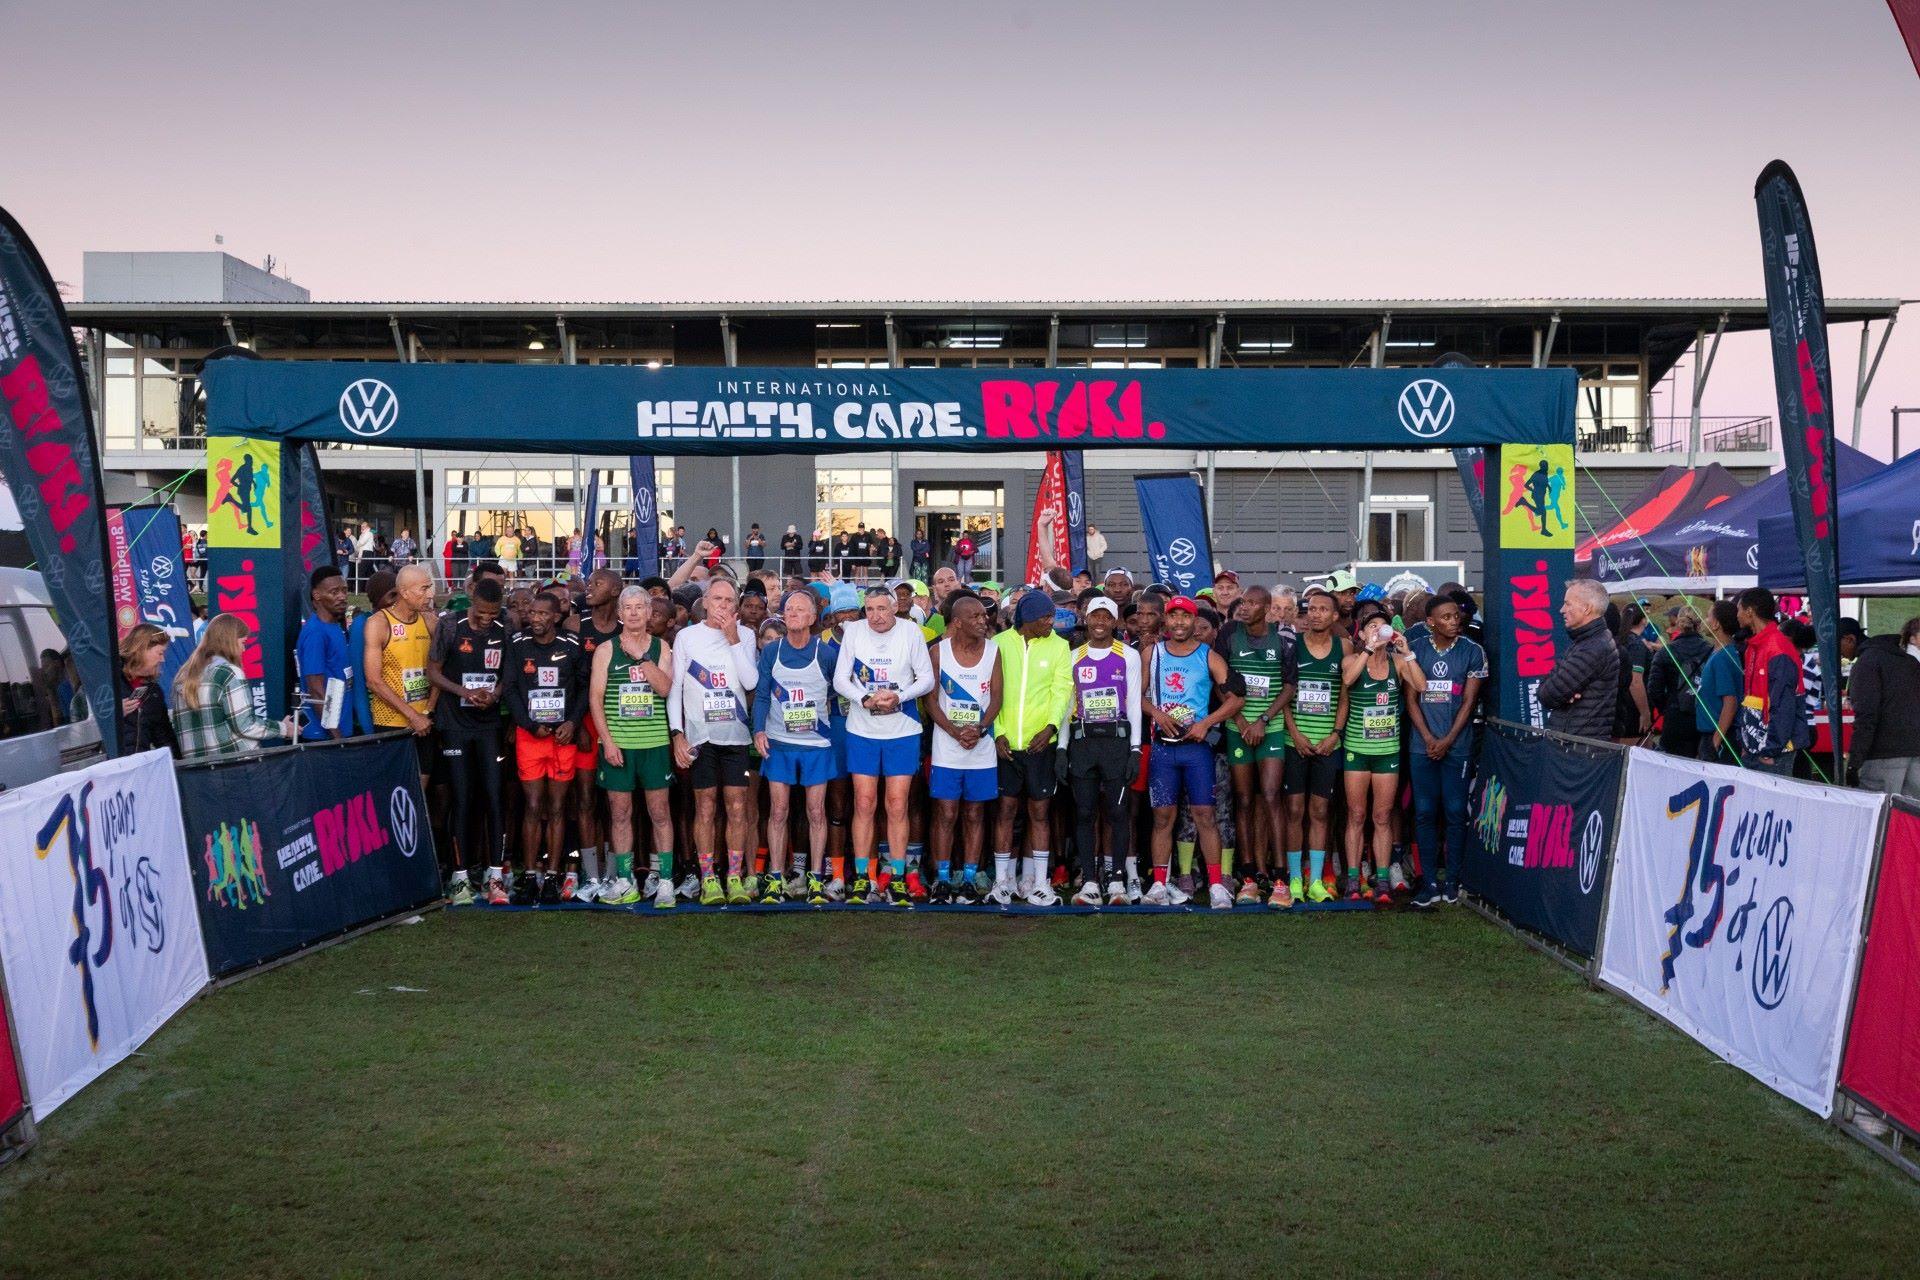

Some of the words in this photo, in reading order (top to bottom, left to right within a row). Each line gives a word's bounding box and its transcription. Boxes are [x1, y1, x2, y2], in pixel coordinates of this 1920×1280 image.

[717, 381, 891, 395] INTERNATIONAL
[339, 378, 399, 437] VW
[637, 401, 827, 439] HEALTH.
[833, 402, 978, 439] CARE.
[981, 380, 1166, 439] RUN.
[1398, 378, 1456, 438] VW
[140, 568, 160, 603] years
[1173, 571, 1196, 588] of
[153, 580, 173, 595] of
[1510, 559, 1556, 678] RUN.
[393, 623, 405, 636] 60
[486, 650, 499, 667] 40
[542, 670, 555, 683] 35
[630, 666, 645, 681] 65
[711, 672, 727, 688] 65
[875, 668, 887, 681] 75
[1081, 667, 1093, 680] 45
[1246, 676, 1266, 687] 397
[1430, 682, 1449, 690] 740
[252, 681, 268, 721] ARE.
[625, 695, 649, 704] 2018
[790, 688, 804, 703] 70
[1089, 698, 1112, 708] 2593
[1302, 692, 1327, 702] 1870
[1376, 692, 1389, 705] 60
[535, 699, 561, 709] 1150
[708, 699, 732, 710] 1881
[788, 710, 812, 720] 2596
[952, 711, 976, 721] 2549
[1369, 718, 1392, 727] 2692
[100, 788, 136, 879] years
[313, 790, 389, 876] RUN.
[1726, 808, 1793, 887] years
[293, 860, 324, 893] CARE.
[1659, 779, 1735, 996] 75
[118, 856, 137, 949] of
[35, 780, 113, 1054] 75
[1726, 877, 1758, 973] of
